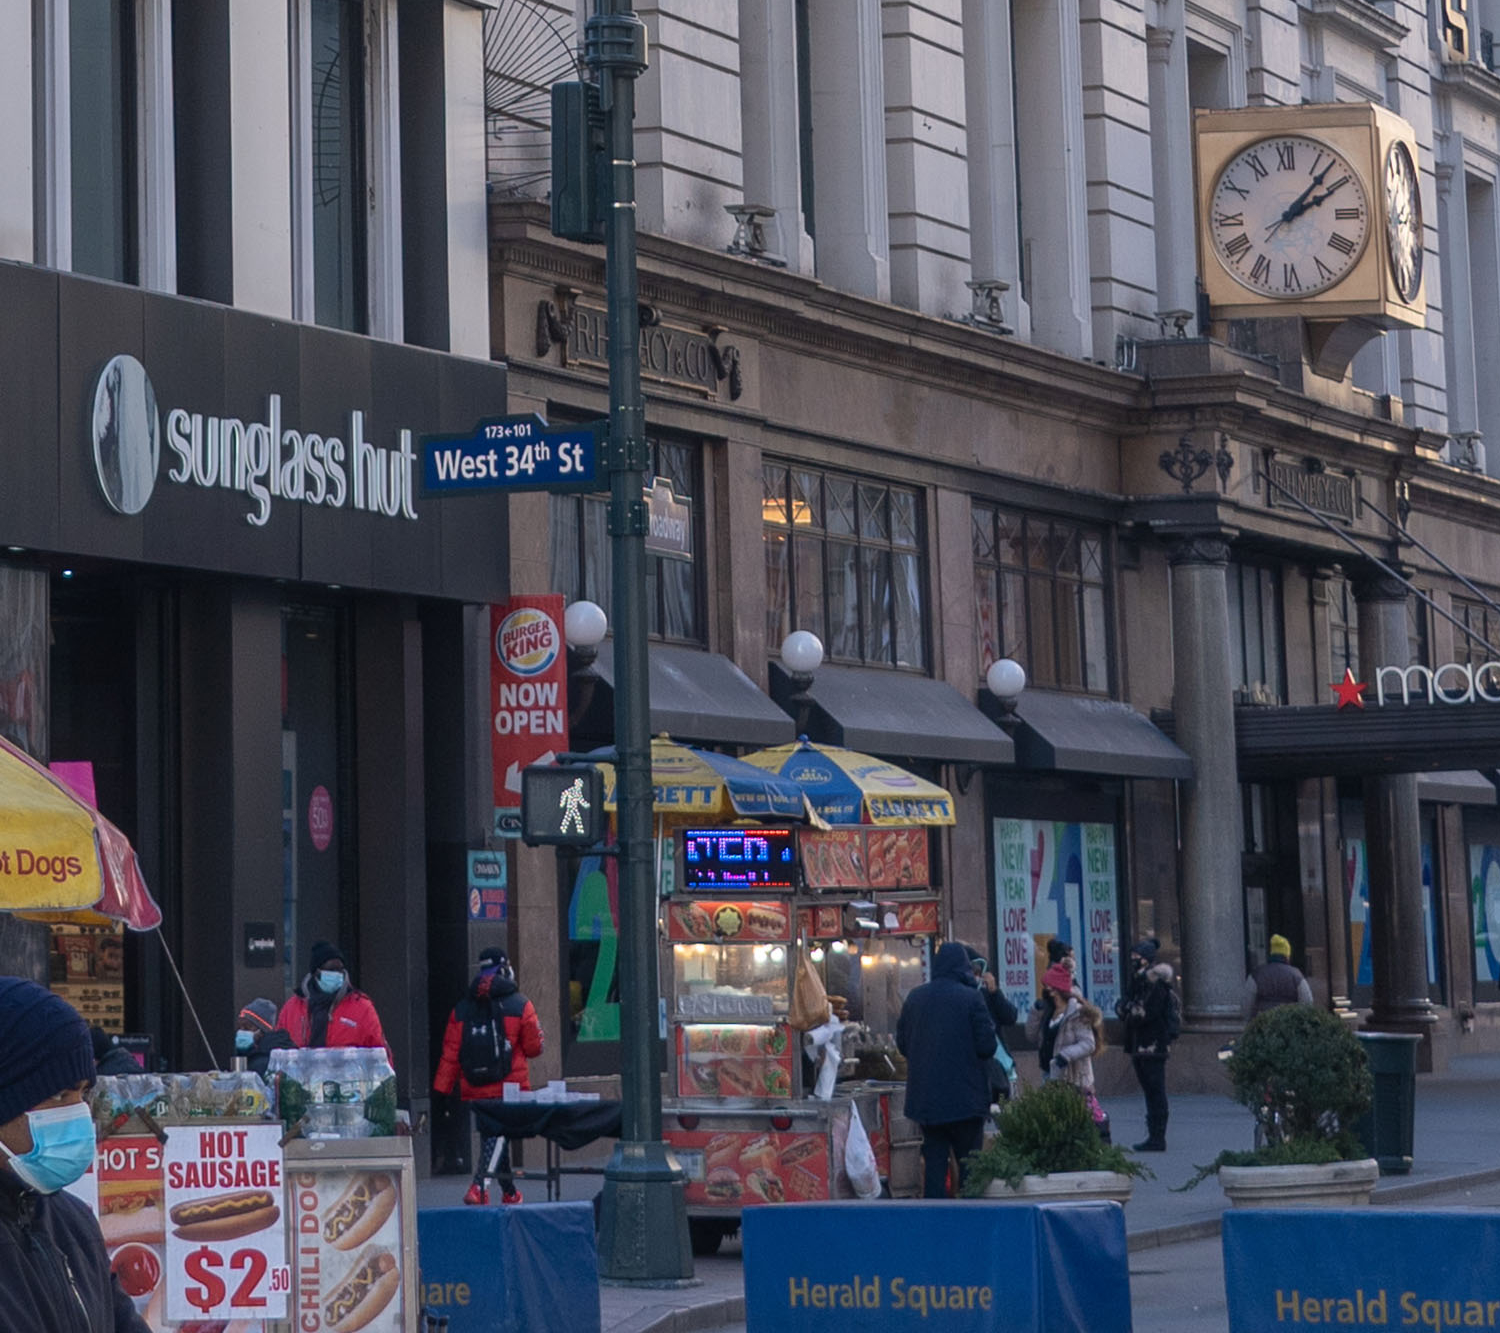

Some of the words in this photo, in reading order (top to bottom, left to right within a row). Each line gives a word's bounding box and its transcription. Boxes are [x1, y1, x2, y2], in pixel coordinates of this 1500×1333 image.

[1276, 145, 1295, 171] XII
[639, 329, 676, 373] ACY
[485, 425, 504, 439] 173
[513, 424, 532, 437] 101
[166, 394, 345, 528] sunglass
[350, 409, 420, 523] hut
[434, 448, 498, 481] West
[505, 440, 550, 477] 34th
[558, 442, 584, 473] St
[503, 620, 550, 645] BURGER
[504, 632, 553, 662] KING
[500, 682, 558, 708] NOW
[495, 709, 564, 735] OPEN
[870, 797, 950, 819] SABRETT
[15, 848, 83, 883] Dogs
[1001, 842, 1024, 870] NEW
[1087, 848, 1109, 873] NEW
[1003, 877, 1026, 901] YEAR
[1089, 880, 1111, 902] YEAR
[1003, 907, 1027, 933] LOVE
[1090, 909, 1112, 933] LOVE
[1005, 937, 1029, 966] GIVE
[199, 1131, 248, 1159] HOT
[168, 1159, 281, 1189] SAUSAGE
[300, 1171, 320, 1235] DOG
[300, 1246, 320, 1333] CHILI
[421, 1277, 471, 1307] uare
[788, 1277, 880, 1309] Herald
[890, 1277, 993, 1315] Square
[1274, 1289, 1388, 1325] Herald
